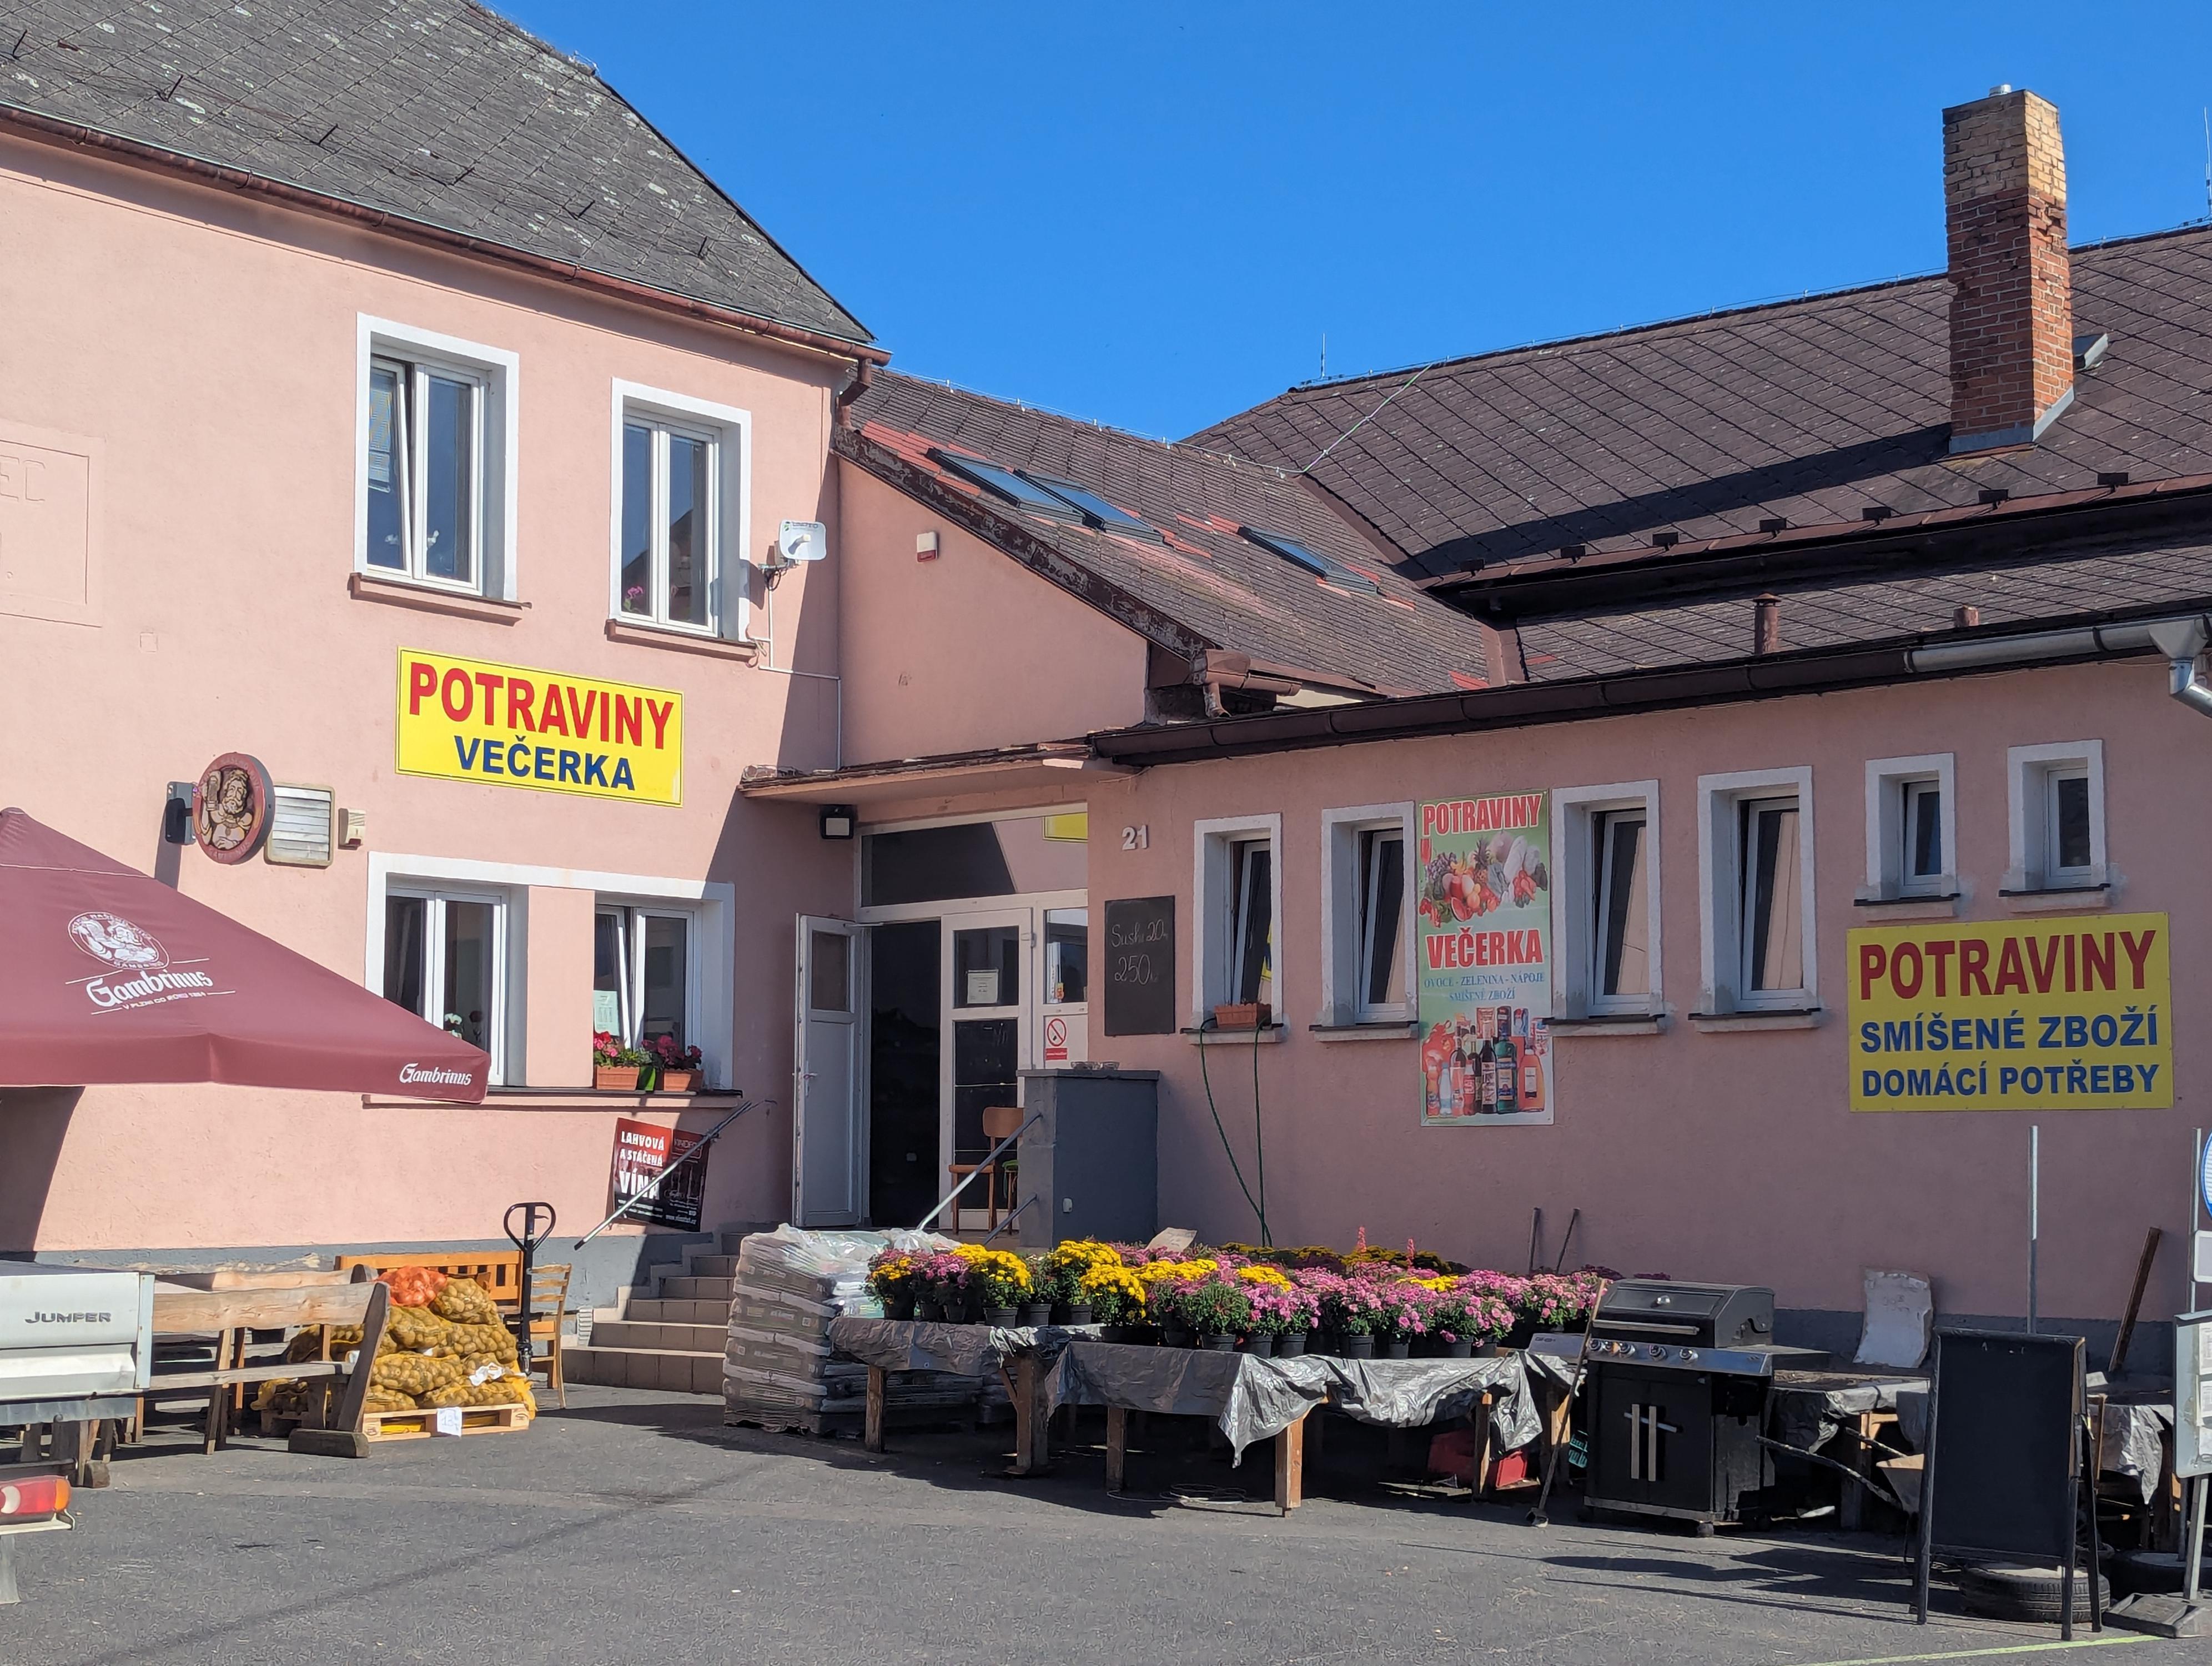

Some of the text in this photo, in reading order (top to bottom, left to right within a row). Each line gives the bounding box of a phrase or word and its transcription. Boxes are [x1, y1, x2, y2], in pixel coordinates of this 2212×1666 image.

[409, 662, 674, 750] POTRAVINY
[455, 735, 635, 791] VEČERKA
[1422, 795, 1541, 836] POTRAVINY
[1122, 825, 1148, 850] 21
[1111, 922, 1144, 947] Sushi
[1426, 926, 1544, 969] VEČERKA
[1424, 976, 1454, 988] OVOCE
[1460, 975, 1504, 986] ZELENINA
[1511, 971, 1545, 983] NÁPOJE
[1859, 930, 2156, 1001] POTRAVINY
[86, 969, 213, 1007] Gambrinus
[1861, 1005, 2159, 1053] SMÍŠENÉ ZBOŽÍ
[399, 1062, 472, 1086] Gambrinus
[1863, 1059, 2160, 1097] DOMÁCÍ POTŘEBY
[620, 1148, 663, 1167] A STÁČENÁ
[621, 1131, 665, 1151] LAHVOVÁ
[619, 1167, 660, 1200] VÍNA
[24, 1311, 111, 1323] JUMPER
